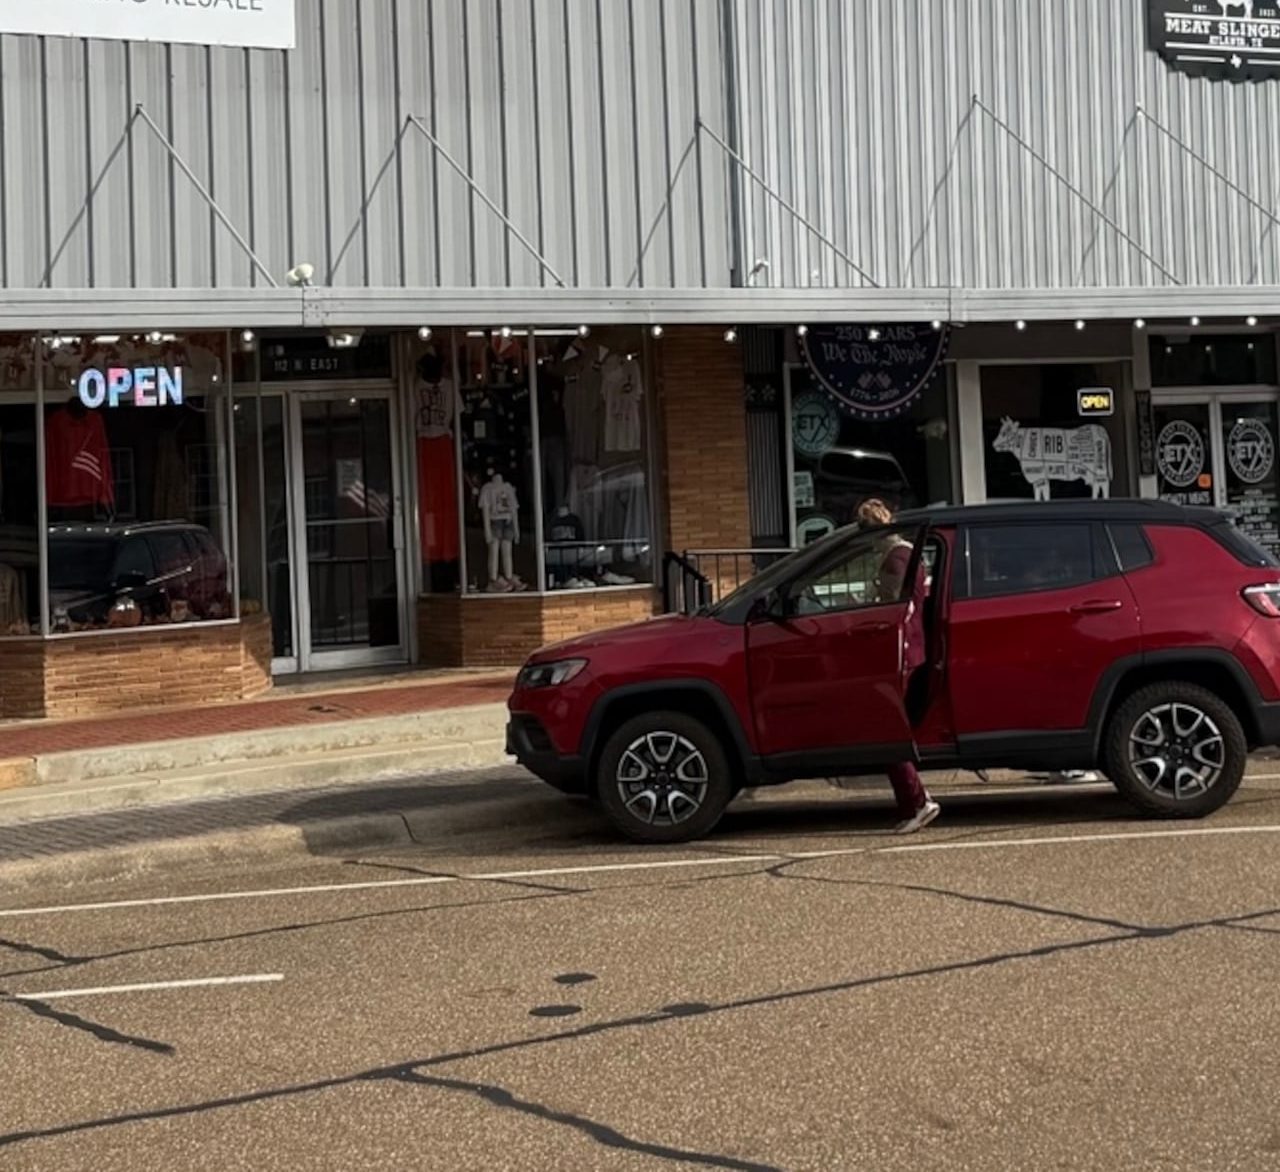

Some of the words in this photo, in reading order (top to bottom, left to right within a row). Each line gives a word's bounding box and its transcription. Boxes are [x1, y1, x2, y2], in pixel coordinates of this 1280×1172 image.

[1165, 18, 1212, 34] MEAT
[834, 325, 862, 341] 250
[821, 341, 849, 363] We
[850, 342, 880, 365] The
[309, 357, 339, 371] EAST
[76, 365, 184, 410] OPEN
[1081, 395, 1109, 409] OPEN
[797, 412, 830, 443] ETX
[1044, 435, 1063, 454] RIB
[1235, 439, 1266, 471] ETX
[1164, 443, 1196, 476] ETX
